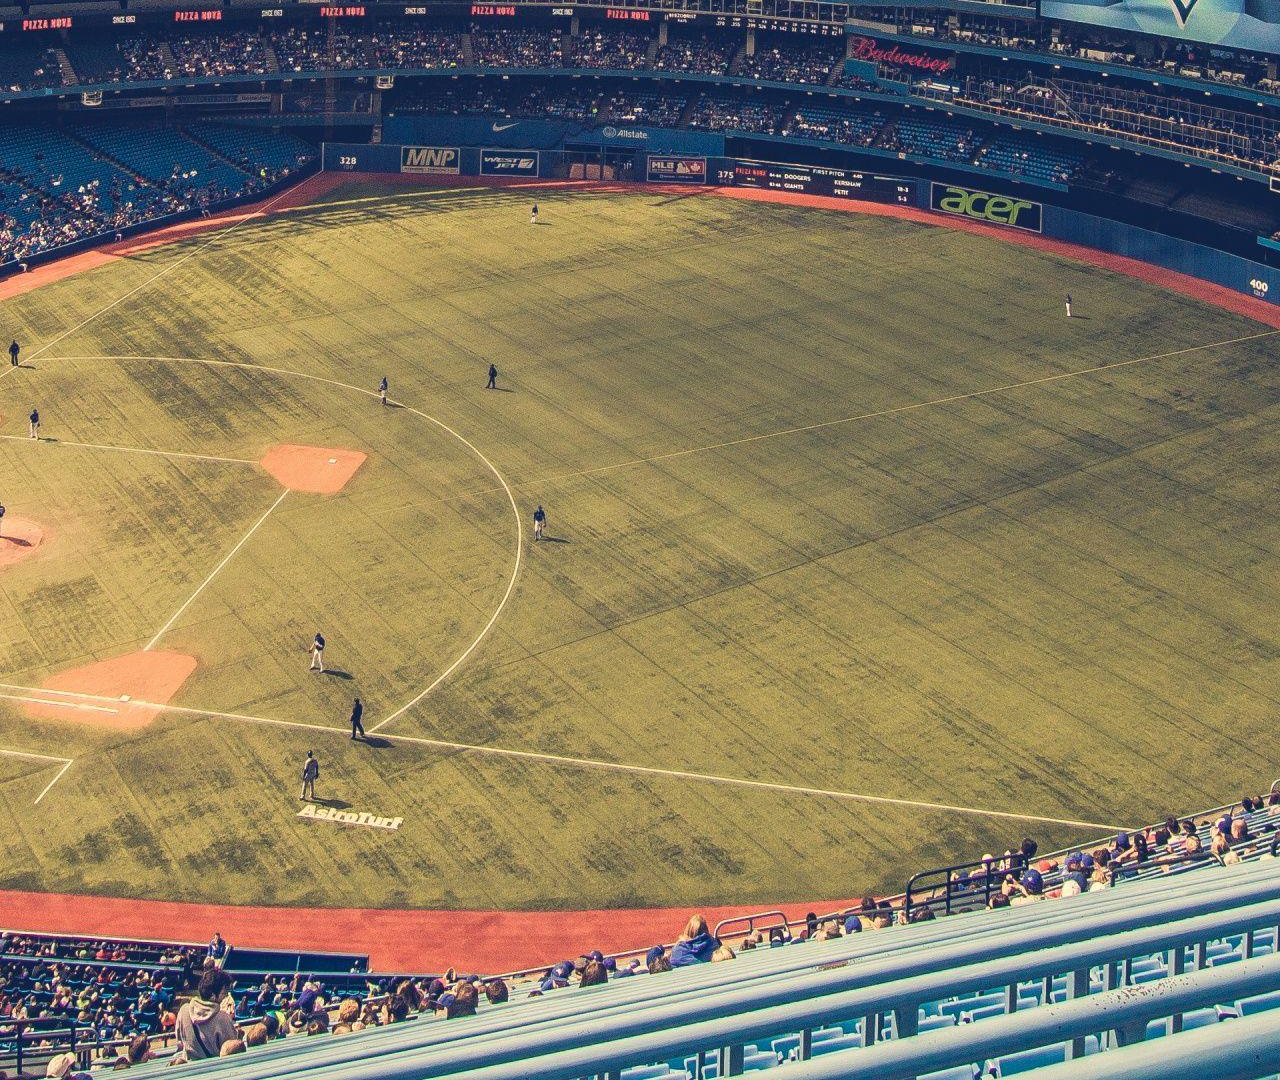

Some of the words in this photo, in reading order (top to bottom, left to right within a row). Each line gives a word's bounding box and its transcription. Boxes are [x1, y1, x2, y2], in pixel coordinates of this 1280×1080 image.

[175, 11, 199, 21] PIZZA
[201, 10, 222, 20] NOVA
[321, 8, 343, 16] PIZZA
[345, 7, 365, 16] NOVA
[472, 6, 494, 15] PIZZA
[496, 6, 516, 15] NOVA
[607, 9, 628, 19] PIZZA
[630, 11, 650, 20] NOVA
[23, 20, 49, 31] PIZZA
[51, 17, 72, 28] NOVA
[852, 36, 951, 72] Budweiser
[617, 130, 648, 139] Allstate
[340, 156, 356, 165] 328
[406, 148, 455, 166] MNP
[651, 161, 674, 170] MLB
[718, 170, 733, 179] 375
[784, 173, 811, 182] DODGERS
[834, 179, 861, 188] KERSHAW
[940, 186, 1032, 225] acer
[1250, 278, 1268, 292] 400
[297, 805, 403, 829] AstroTurf
